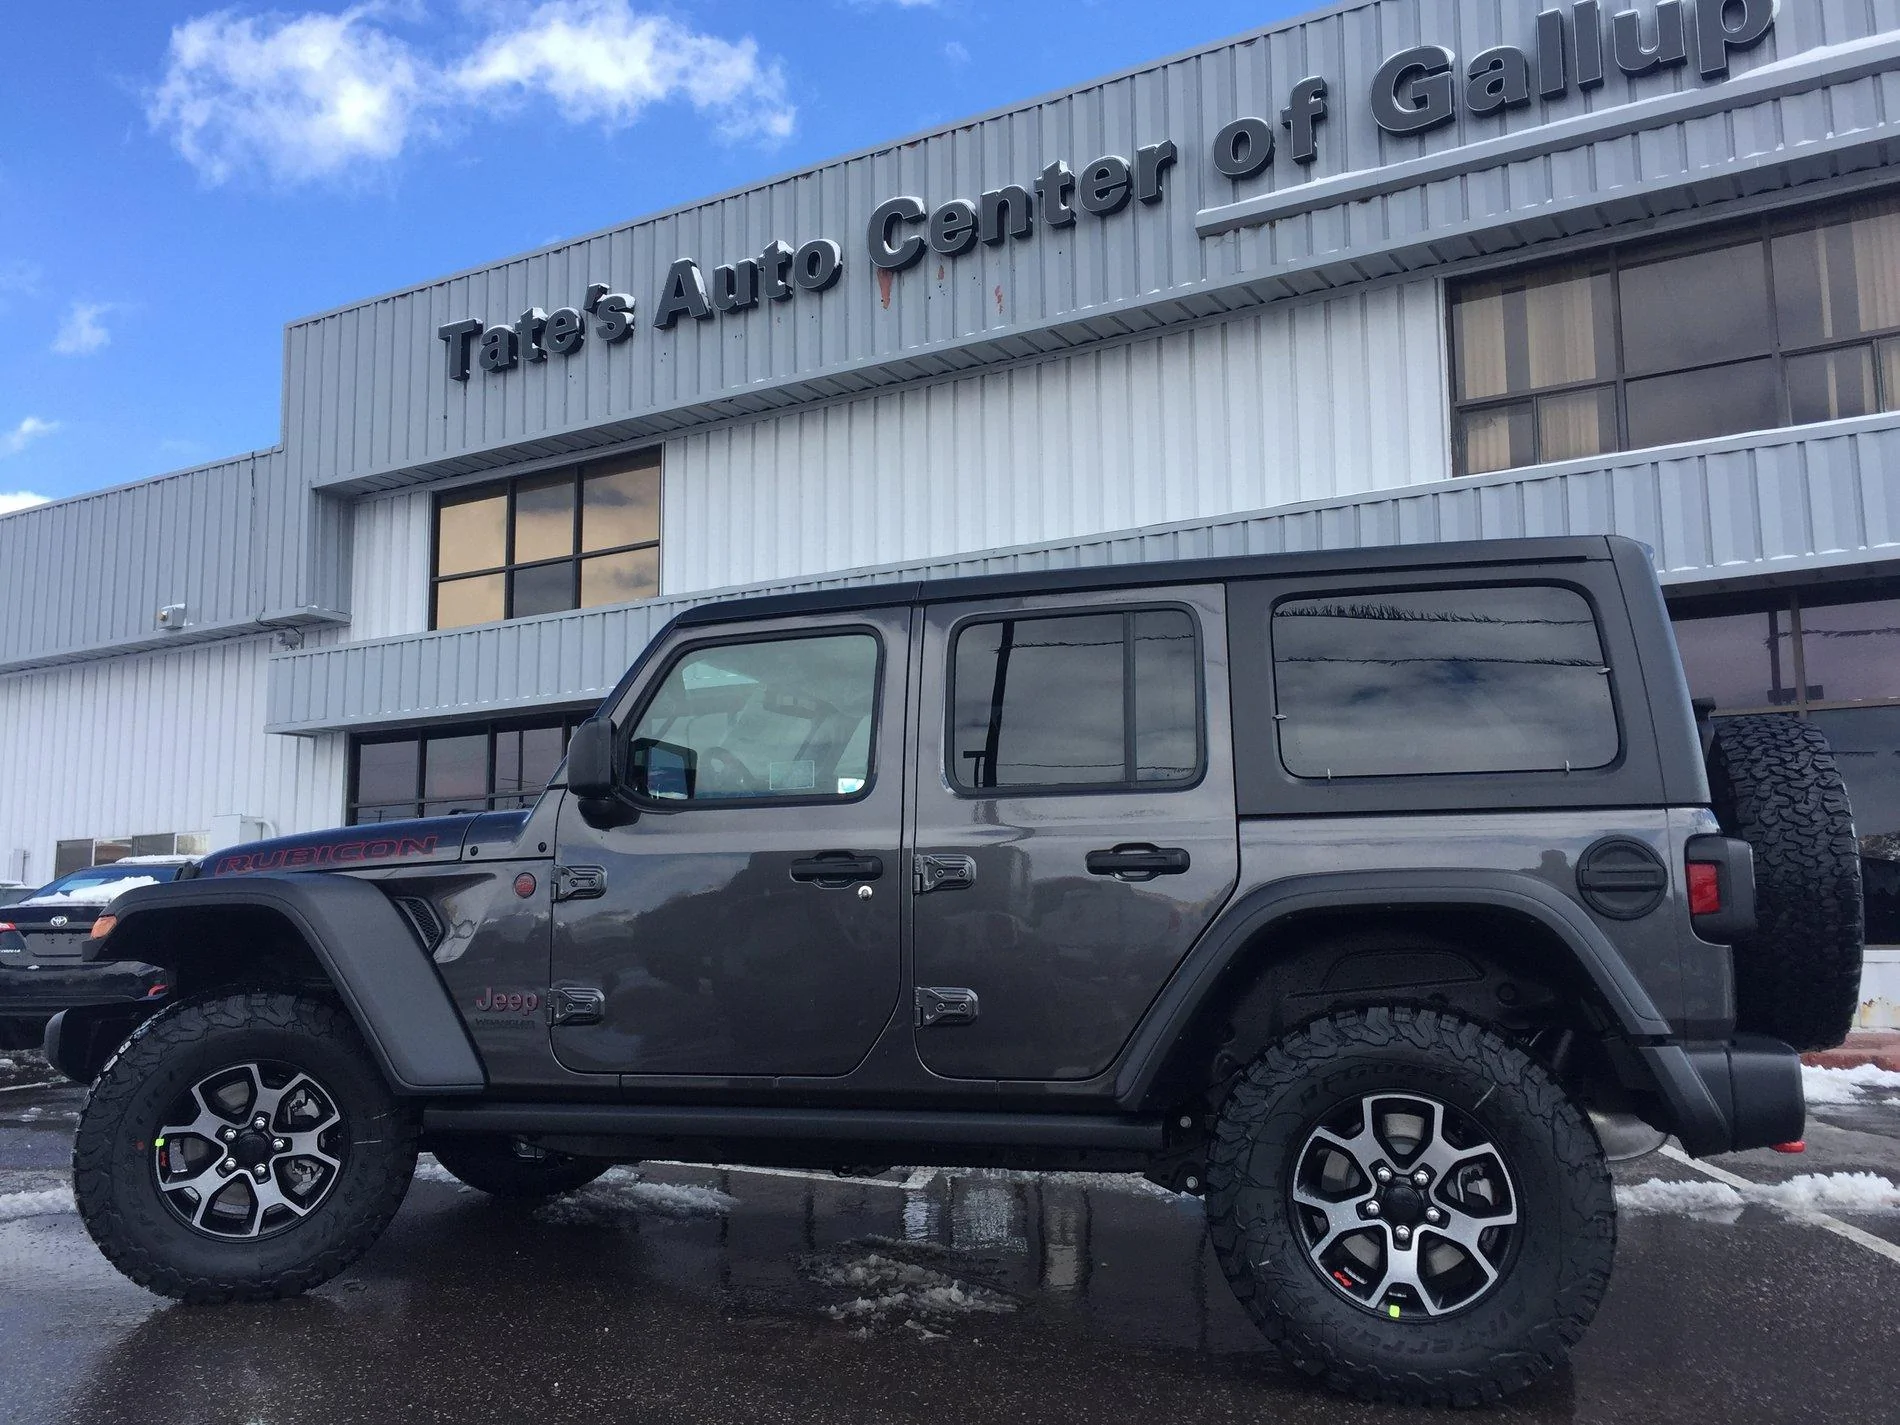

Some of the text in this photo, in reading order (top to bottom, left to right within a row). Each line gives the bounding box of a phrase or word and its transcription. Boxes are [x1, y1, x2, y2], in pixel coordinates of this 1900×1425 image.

[438, 0, 1780, 381] Tate's Auto Center of Gallup
[214, 836, 439, 876] RUBICON
[475, 987, 539, 1016] Jeep
